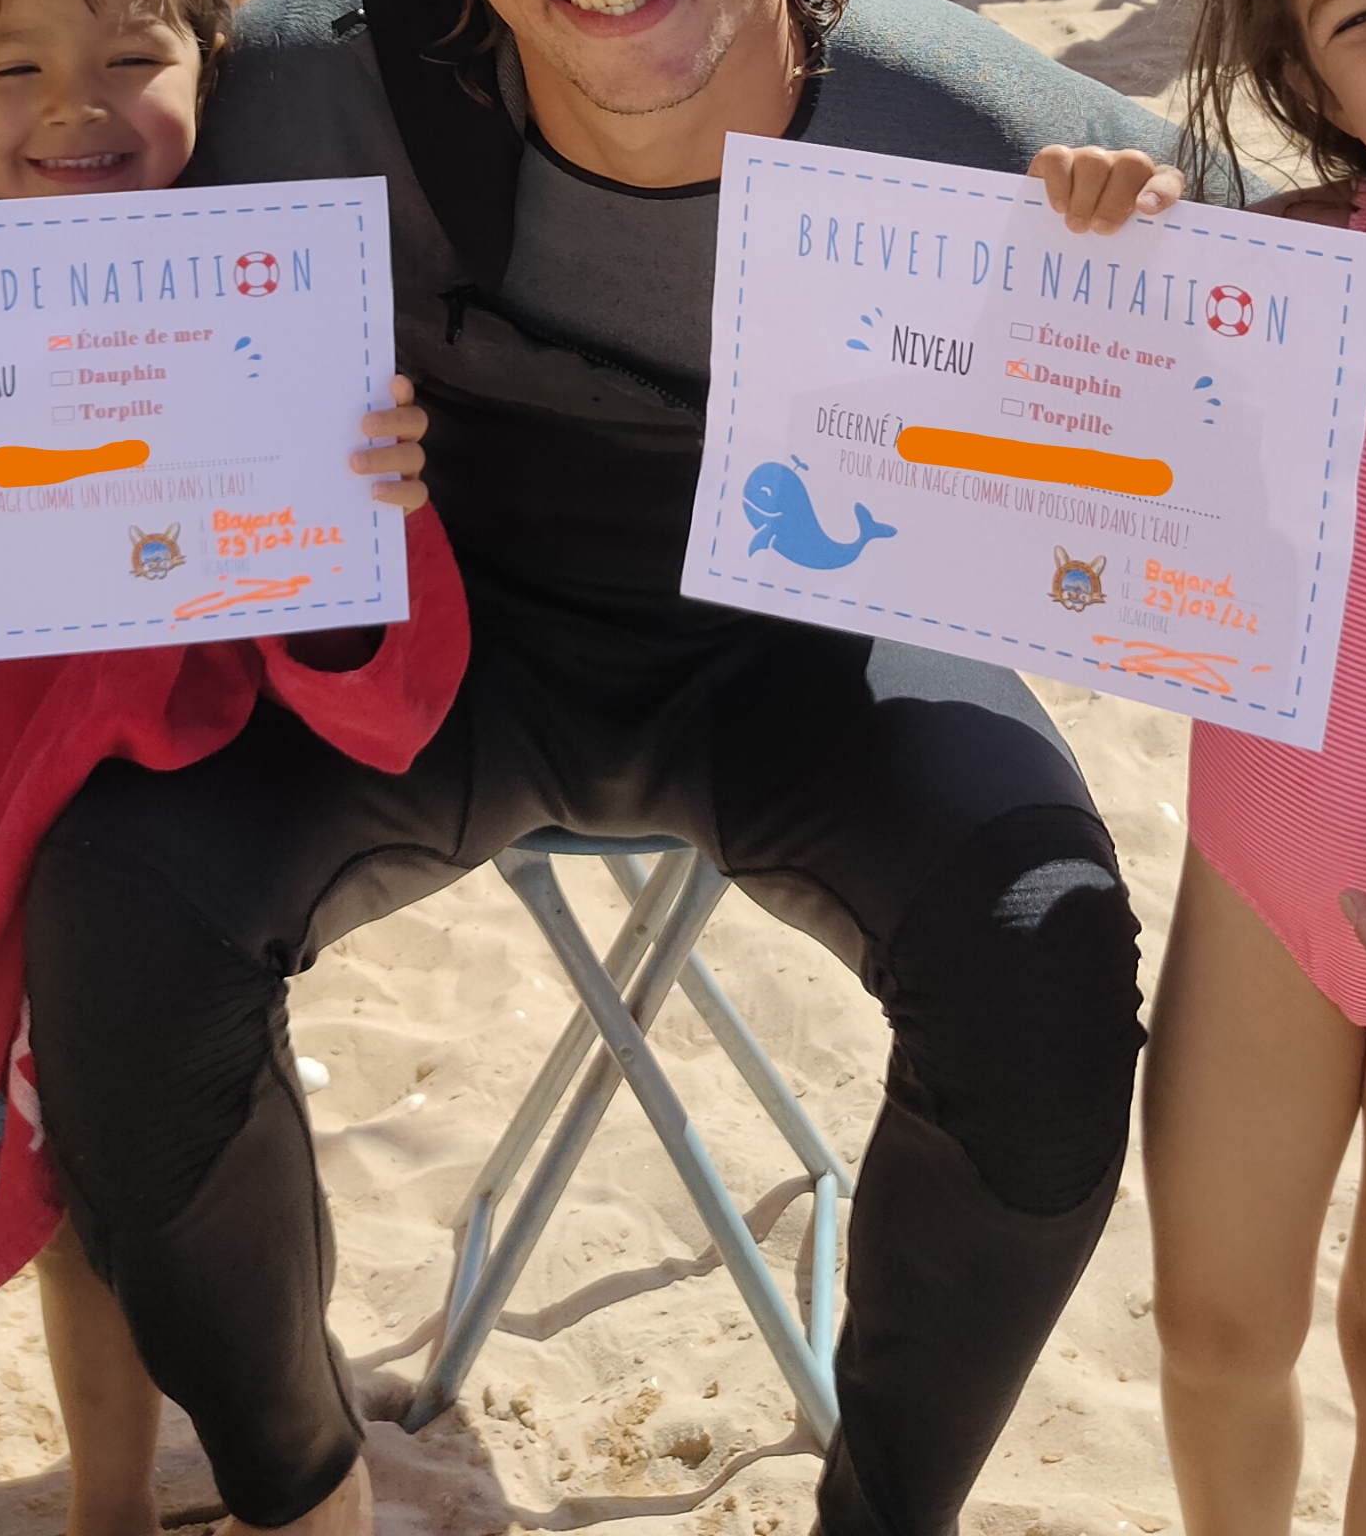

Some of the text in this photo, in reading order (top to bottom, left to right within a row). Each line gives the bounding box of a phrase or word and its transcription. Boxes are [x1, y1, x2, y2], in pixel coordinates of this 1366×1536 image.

[0, 265, 45, 312] DE
[69, 247, 312, 307] NATATION
[798, 213, 1289, 345] BREVET DE NATATION
[76, 327, 214, 351] Étoile de mer
[891, 324, 974, 376] NIVEAU
[1035, 322, 1177, 371] Étoile de mer
[78, 363, 167, 387] Dauphin
[1034, 364, 1122, 399] Dauphin
[79, 398, 165, 422] Torpille
[815, 402, 892, 448] DÉCERNÉ
[1028, 402, 1114, 437] Torpille
[26, 483, 76, 513] COMME
[80, 481, 101, 509] UN
[105, 474, 164, 507] POISSON
[167, 474, 204, 502] DANS
[838, 449, 873, 479] POUR
[876, 457, 919, 489] AVOIR
[921, 466, 961, 498] NAGÉ
[961, 473, 1011, 509] COMME
[1013, 485, 1036, 513] UN
[1036, 490, 1098, 530] POISSON
[1099, 505, 1137, 538] DANS
[1140, 514, 1181, 549] L'EAU
[1145, 558, 1237, 597] Bayard
[1118, 606, 1169, 634] SIGNATURE
